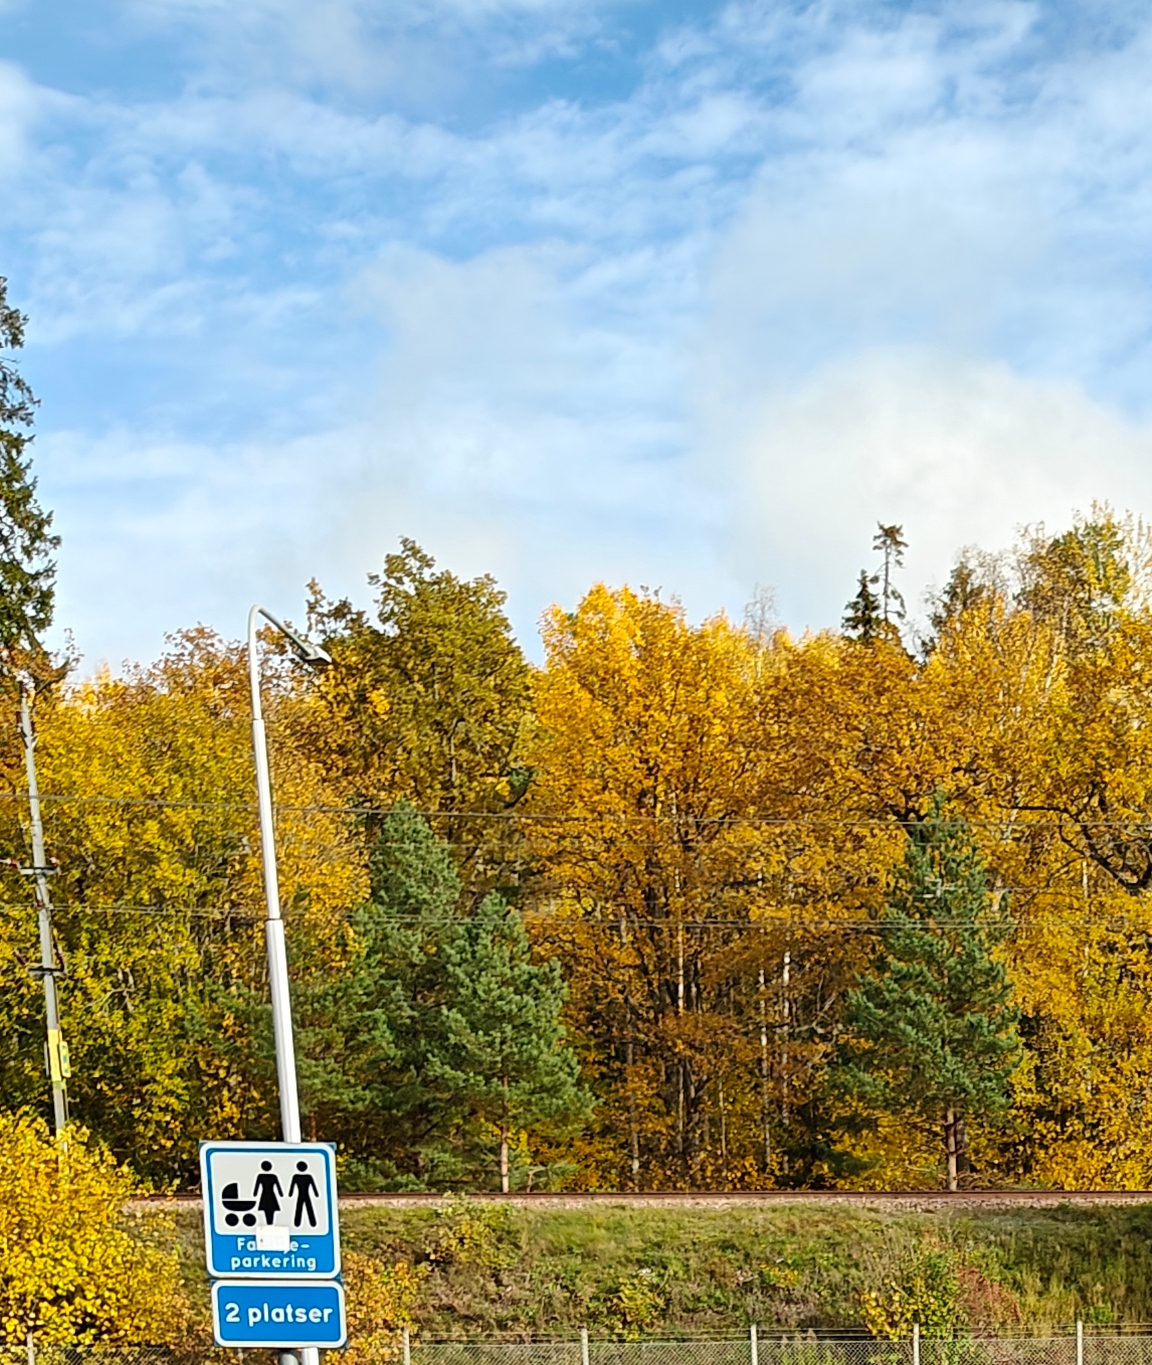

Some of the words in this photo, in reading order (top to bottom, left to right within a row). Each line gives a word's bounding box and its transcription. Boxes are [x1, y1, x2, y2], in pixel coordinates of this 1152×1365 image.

[237, 1237, 310, 1254] Fae-
[231, 1254, 317, 1271] parkering
[224, 1302, 241, 1323] 2
[248, 1302, 333, 1327] platser
